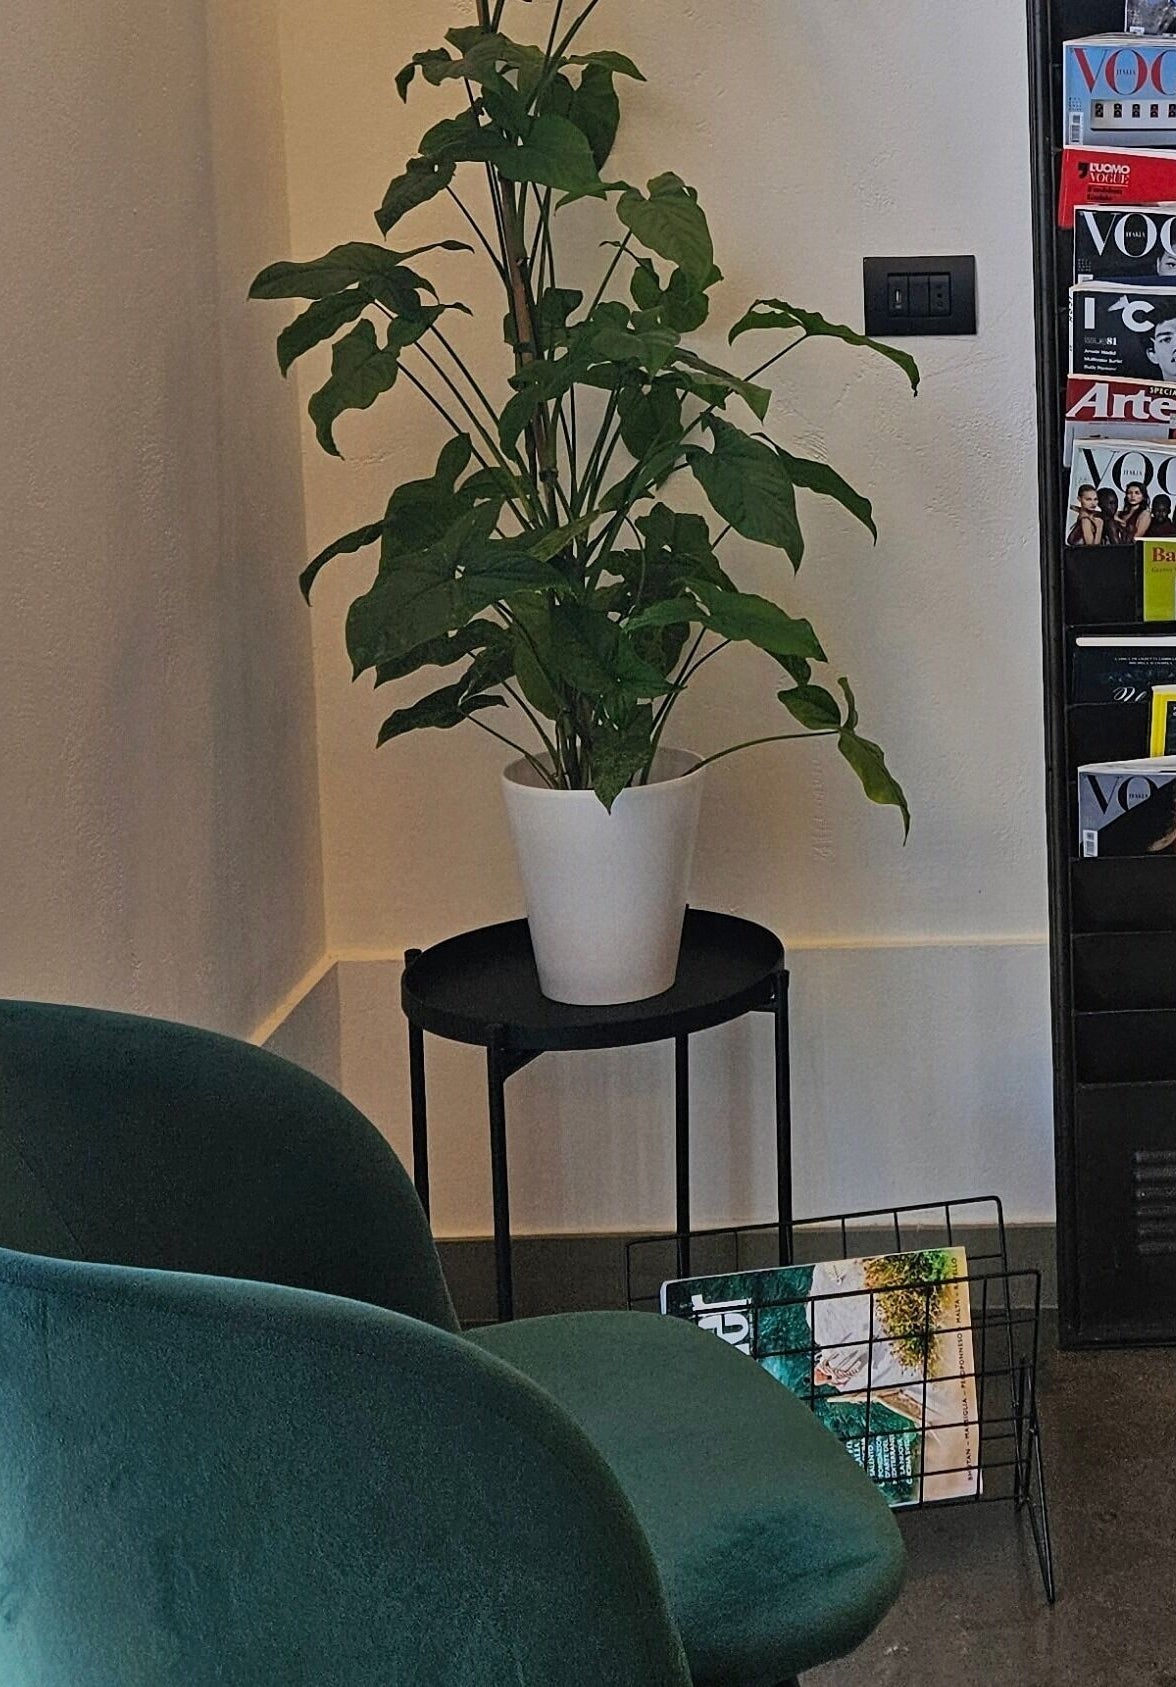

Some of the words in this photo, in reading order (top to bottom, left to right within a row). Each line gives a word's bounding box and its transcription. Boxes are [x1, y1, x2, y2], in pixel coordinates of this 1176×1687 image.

[1090, 172, 1130, 184] VOGUE
[957, 1332, 966, 1389] PEOPONNESO
[905, 1455, 913, 1485] CCINA
[965, 1448, 973, 1481] BHTAN
